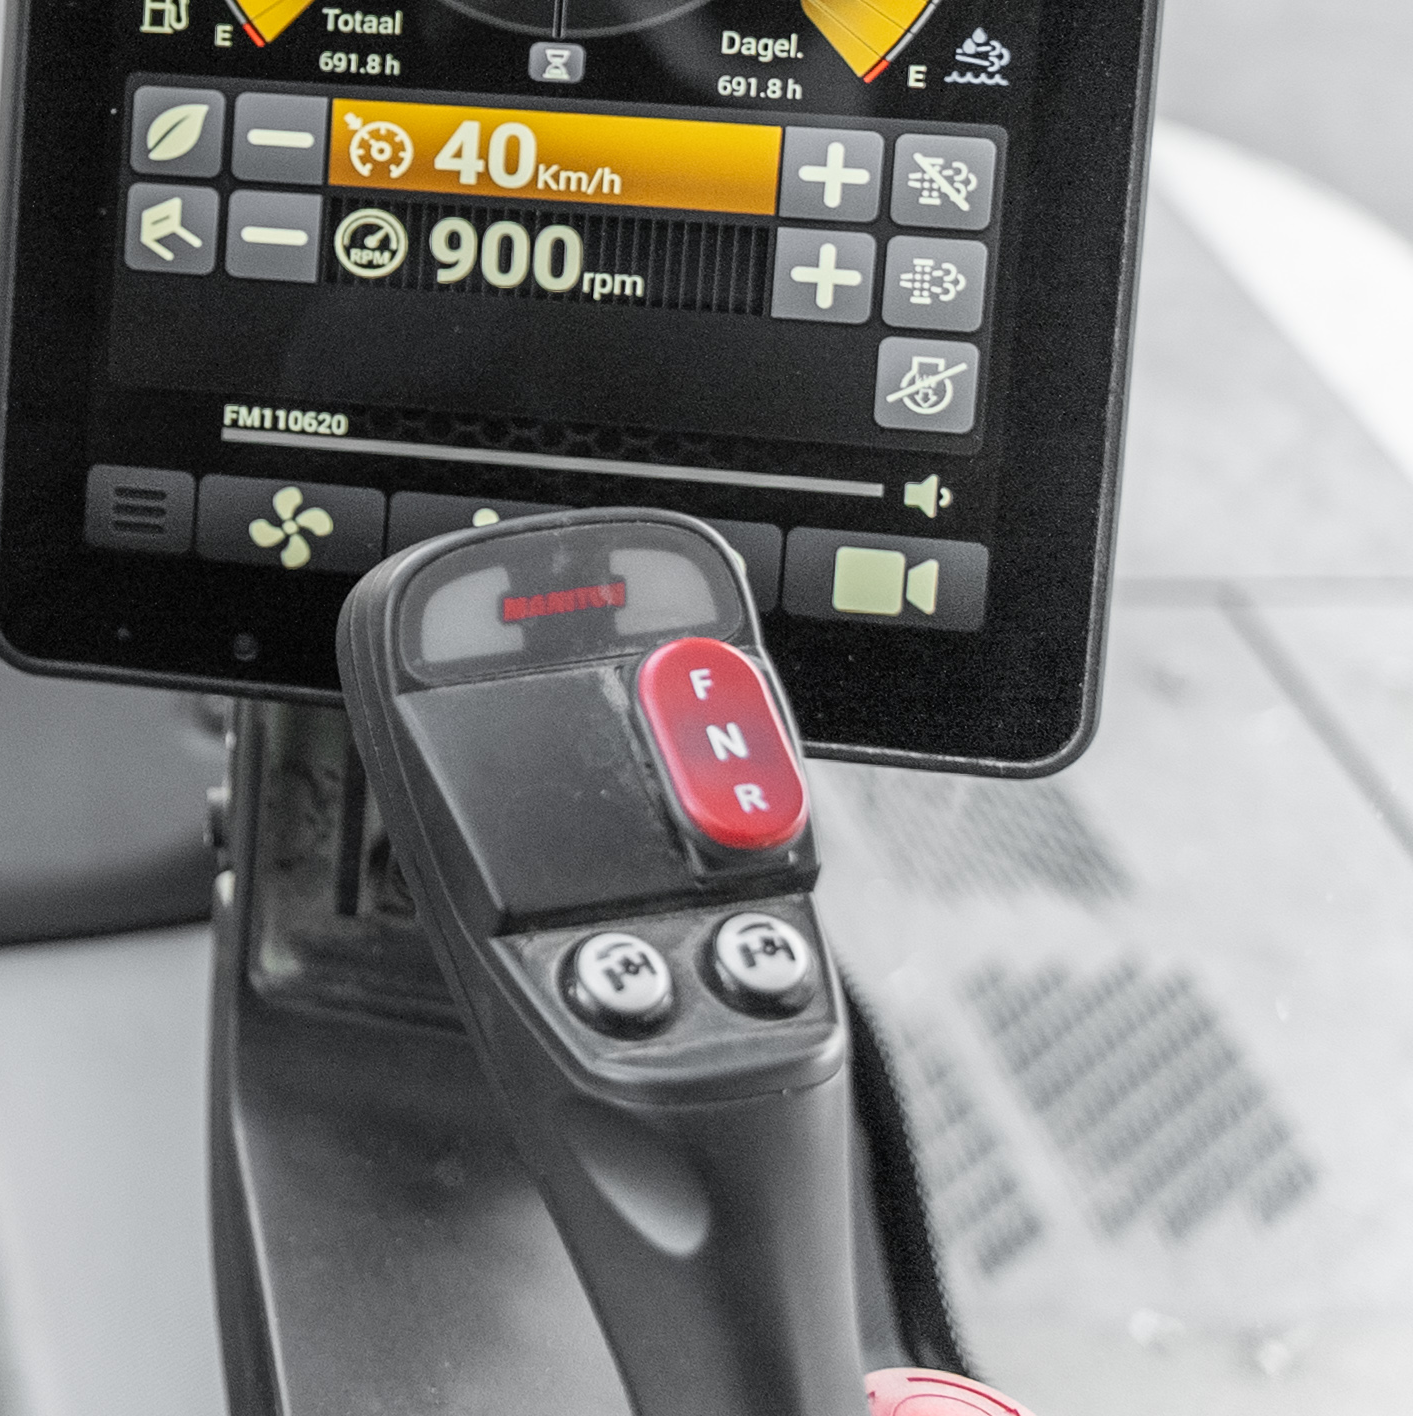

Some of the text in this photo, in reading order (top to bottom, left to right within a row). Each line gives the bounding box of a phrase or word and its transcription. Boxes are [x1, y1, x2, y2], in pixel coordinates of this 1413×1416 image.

[214, 24, 233, 47] E
[322, 7, 403, 35] Totaal
[721, 30, 804, 63] Dagel.
[907, 64, 927, 88] E
[349, 248, 392, 266] RPM
[223, 403, 349, 435] FM110620
[689, 668, 713, 700] F
[706, 722, 748, 761] N
[733, 783, 769, 813] R
